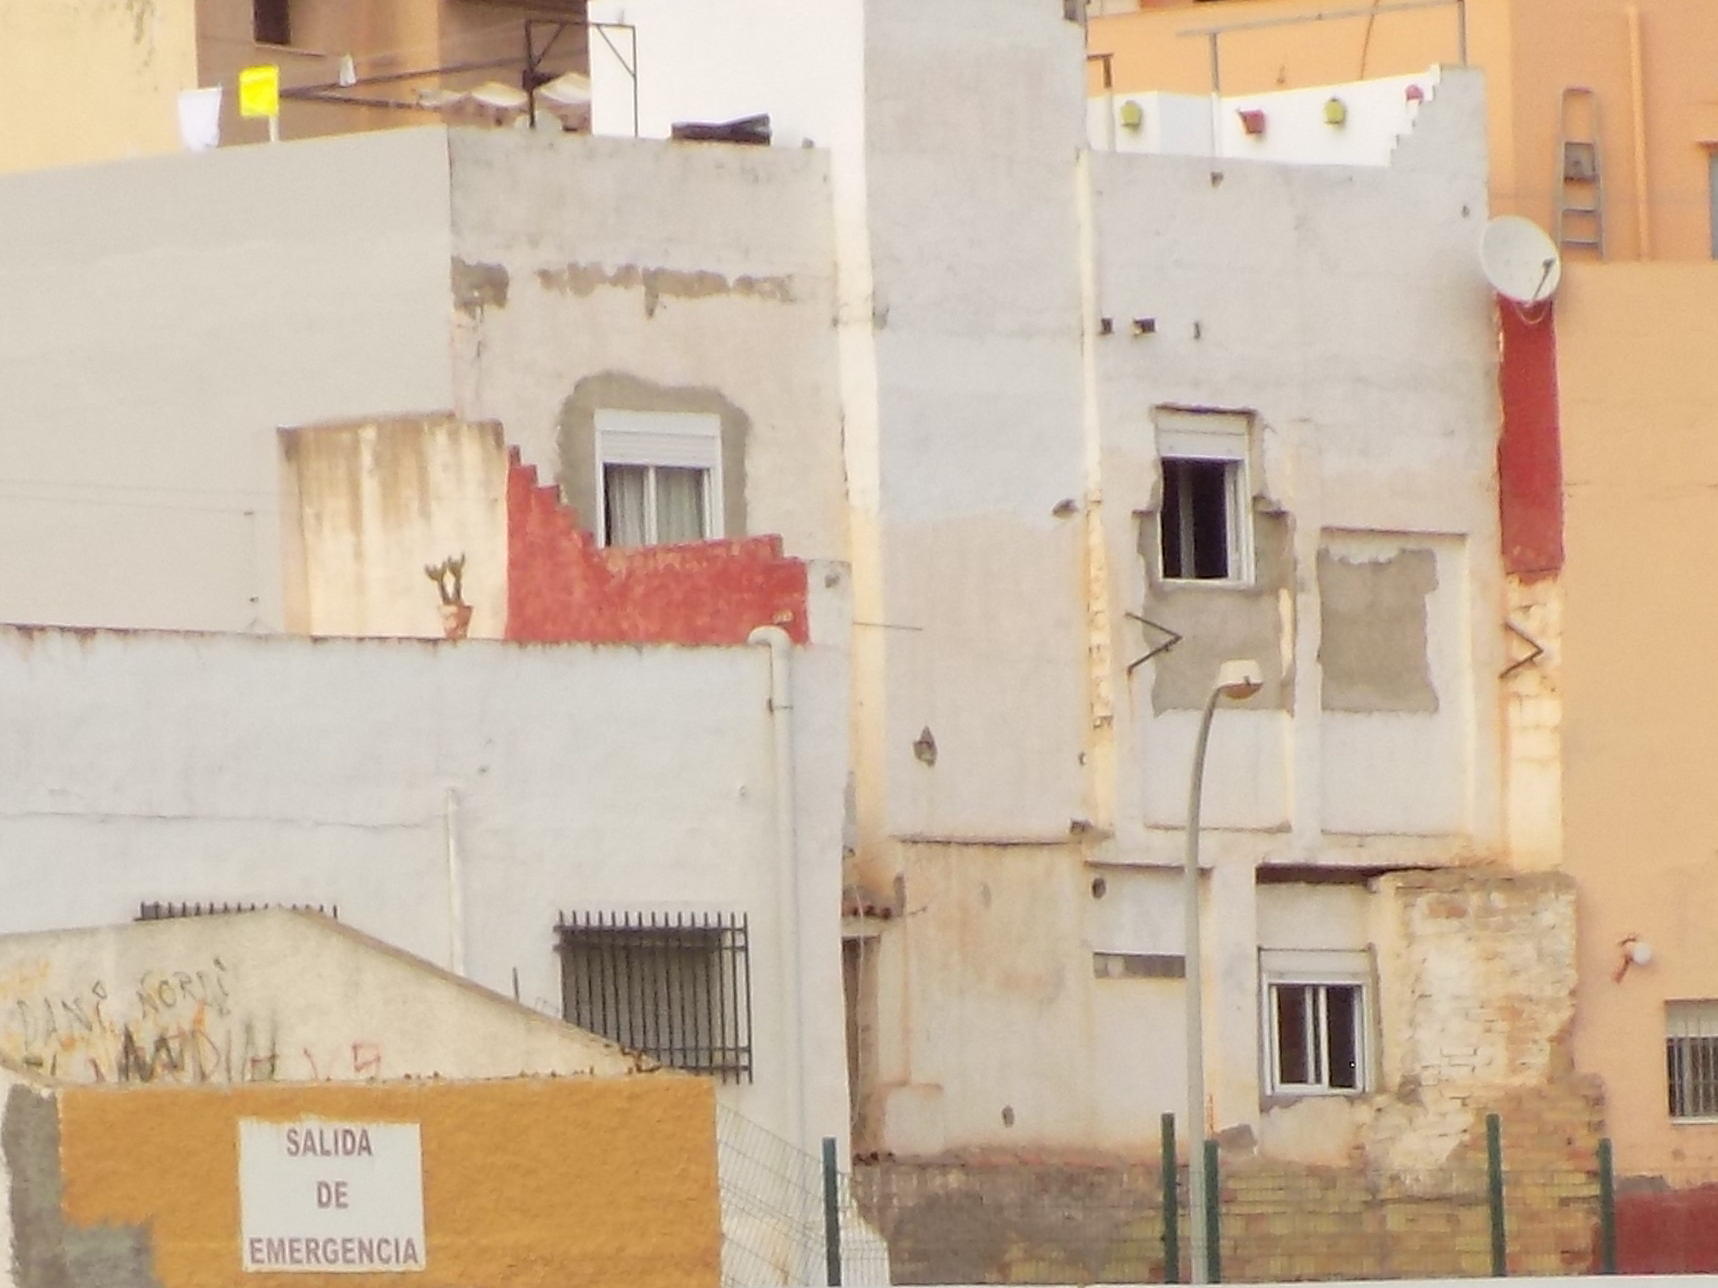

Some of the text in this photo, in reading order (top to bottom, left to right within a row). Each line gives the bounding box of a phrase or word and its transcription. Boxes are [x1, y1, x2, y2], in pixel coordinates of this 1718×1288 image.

[286, 1127, 373, 1157] SALIDA
[316, 1181, 349, 1209] DE
[249, 1237, 419, 1265] EMERGENCIA
